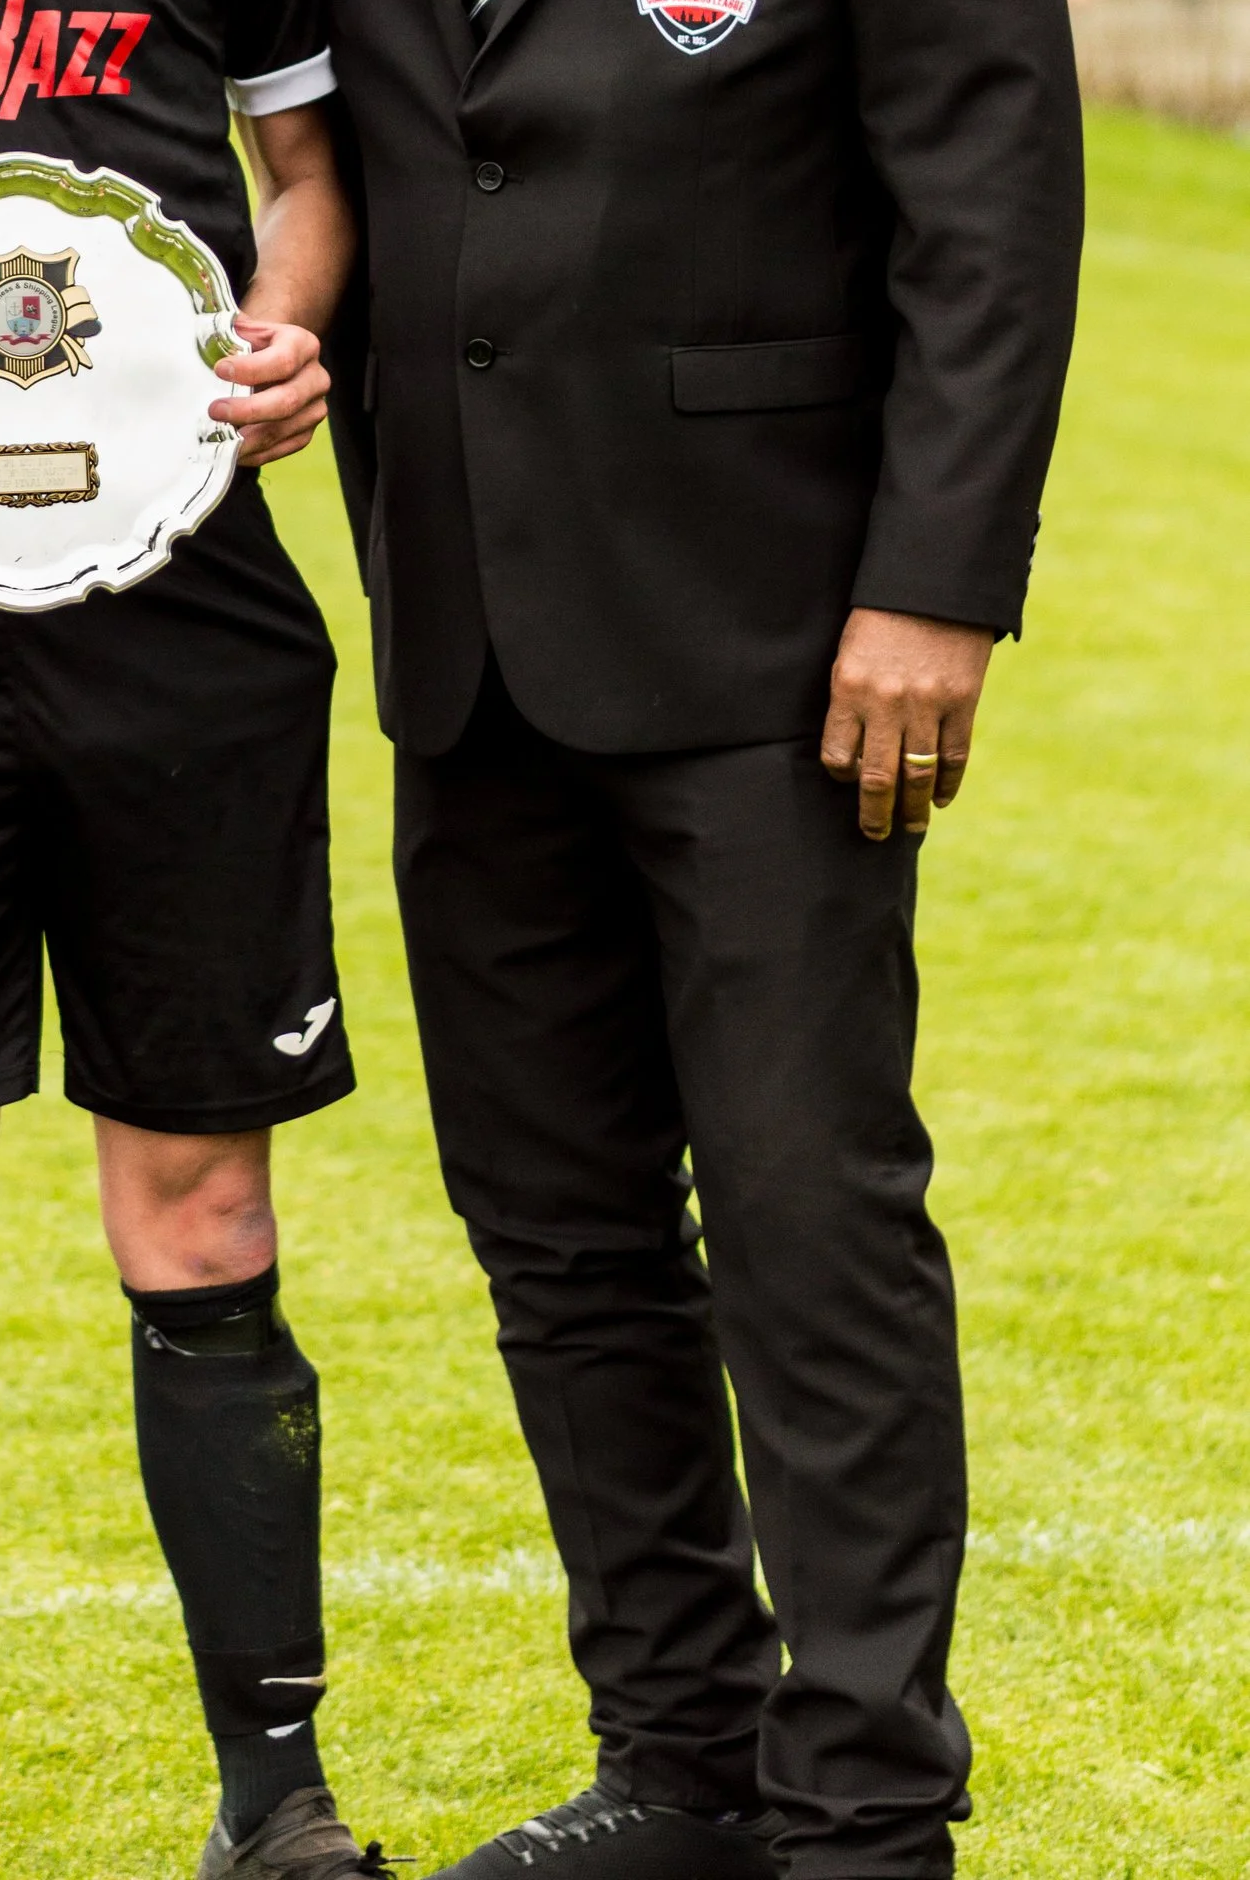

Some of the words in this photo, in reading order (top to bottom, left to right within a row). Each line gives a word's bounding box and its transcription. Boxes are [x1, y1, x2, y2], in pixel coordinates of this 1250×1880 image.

[15, 282, 21, 290] &
[23, 282, 54, 305] Shipping
[50, 304, 59, 334] League
